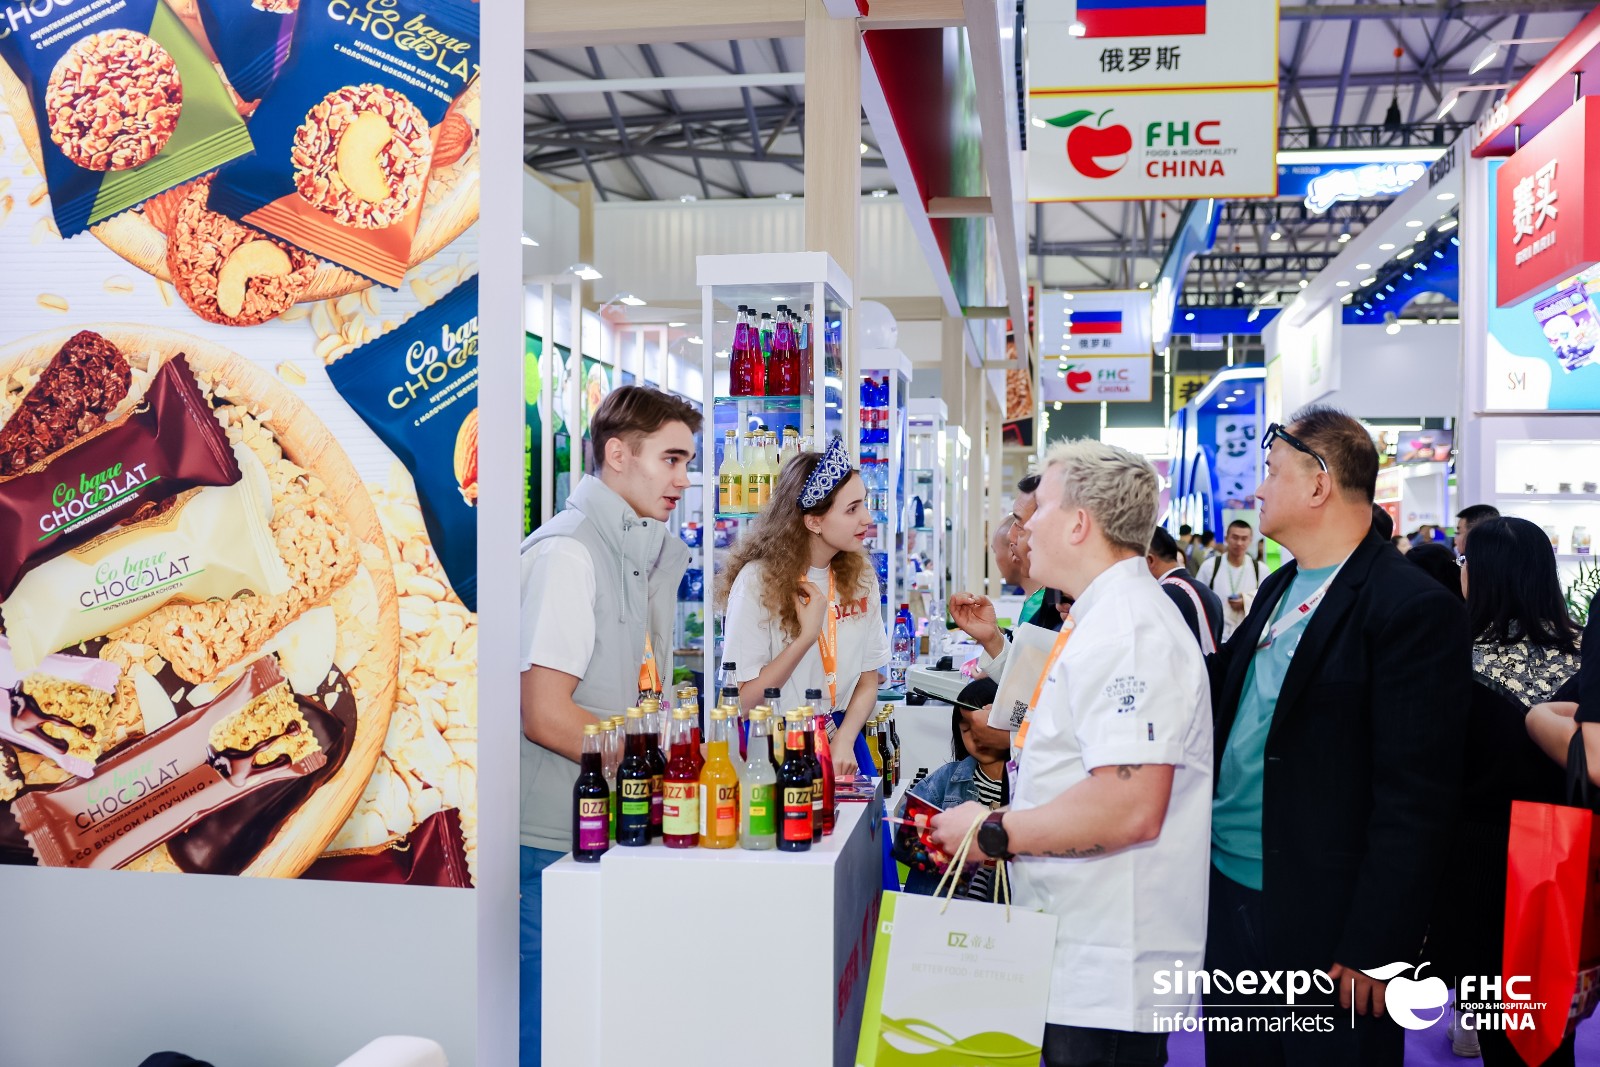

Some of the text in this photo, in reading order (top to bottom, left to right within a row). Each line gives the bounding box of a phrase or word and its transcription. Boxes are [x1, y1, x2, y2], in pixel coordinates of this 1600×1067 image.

[403, 13, 471, 54] barre
[339, 47, 382, 69] молочным
[381, 63, 427, 90] шоколадом
[353, 39, 449, 89] мультизлаковая конфета
[1100, 46, 1181, 72] 俄罗斯
[1145, 120, 1221, 147] FHC
[1146, 160, 1225, 177] CHINA
[405, 341, 438, 375] Co
[1079, 338, 1111, 348] 俄罗斯
[1098, 369, 1128, 380] FHC
[1098, 385, 1130, 393] CHINA
[39, 463, 150, 532] CHOCOLAT
[52, 462, 123, 507] Co barre
[80, 556, 190, 607] CHOCOLAT
[95, 551, 167, 585] Co barre
[75, 759, 181, 829] CHOCOLAT
[94, 818, 141, 850] ВКУСОМ
[143, 781, 207, 822] КАПУЧИНО
